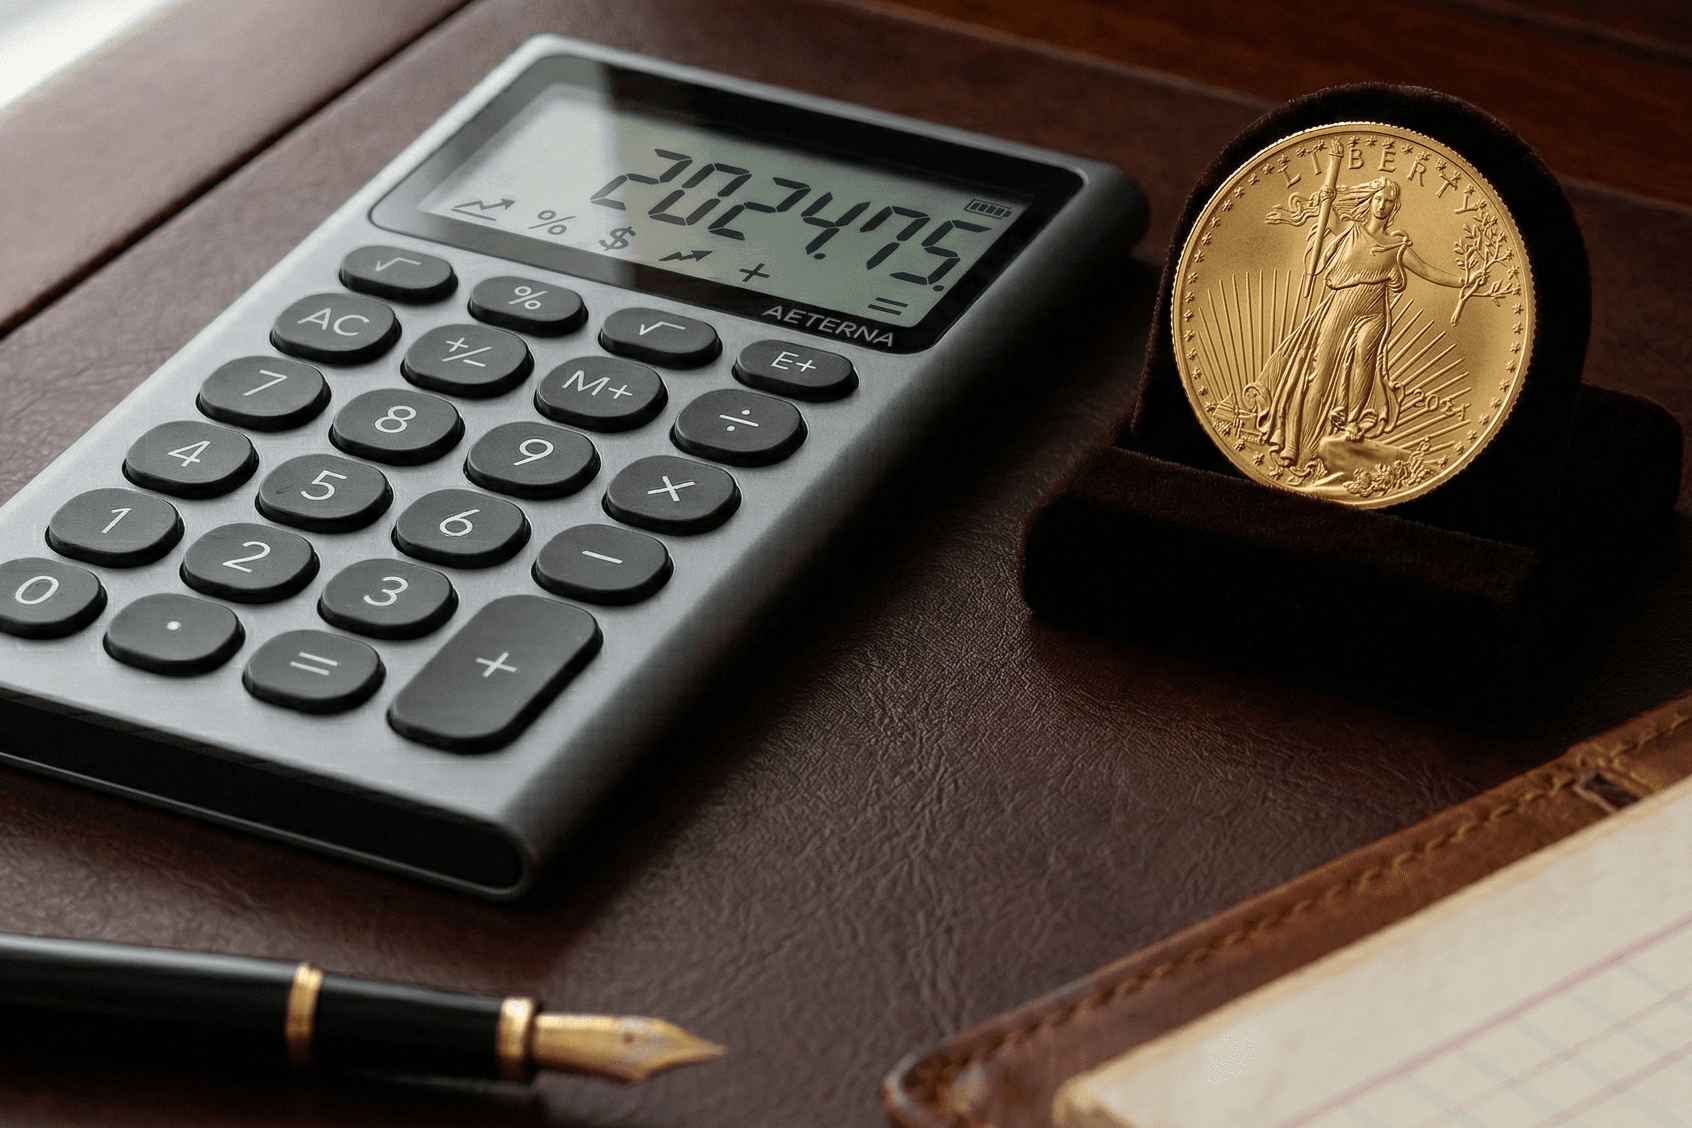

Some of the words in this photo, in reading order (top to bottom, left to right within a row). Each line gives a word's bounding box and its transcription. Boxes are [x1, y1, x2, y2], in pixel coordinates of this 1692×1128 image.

[1278, 149, 1486, 214] LIBERTY
[599, 226, 637, 252] $
[508, 280, 548, 310] %
[297, 307, 370, 337] AC
[761, 305, 894, 347] AETERNA
[770, 350, 817, 374] E+
[242, 369, 288, 397] 7
[561, 369, 633, 400] M+
[374, 405, 417, 434] 8
[167, 440, 211, 467] 4
[513, 438, 554, 467] 9
[300, 469, 347, 501] 5
[101, 507, 132, 534] 1
[439, 508, 480, 537] 6
[222, 541, 271, 573] 2
[14, 575, 59, 605] 0
[363, 576, 409, 607] 3
